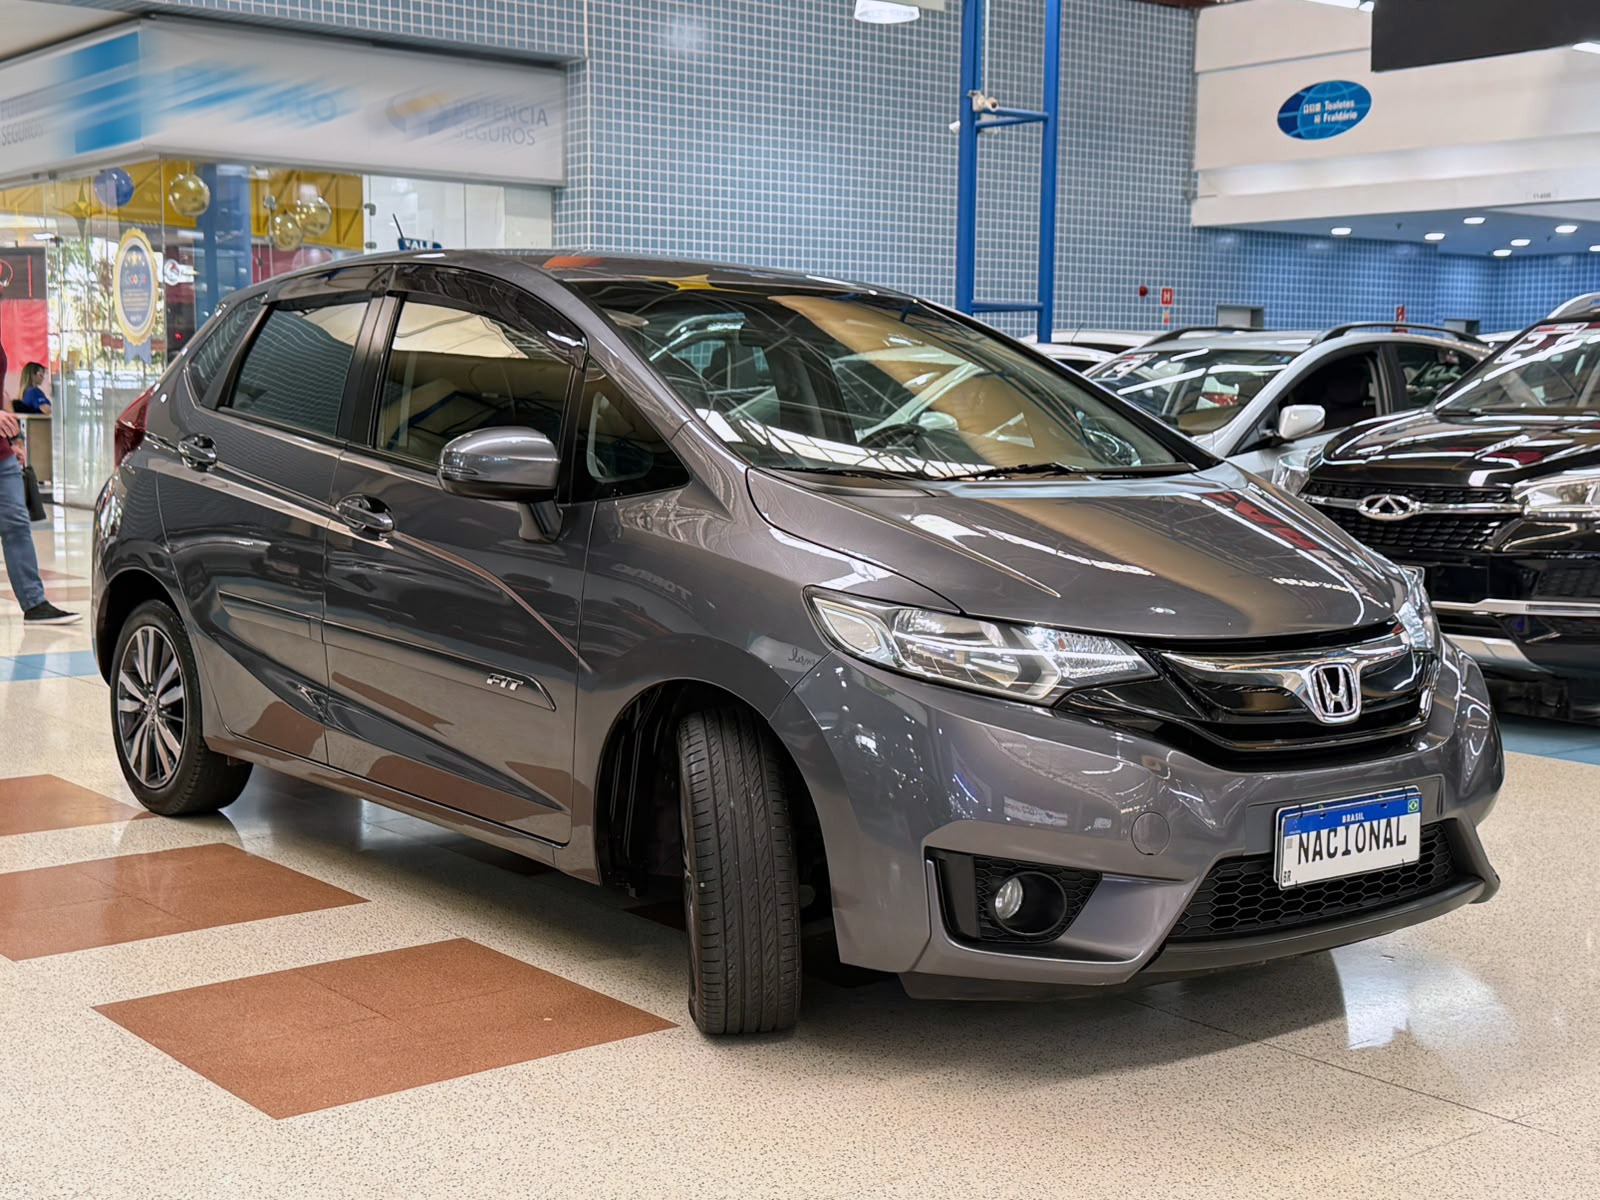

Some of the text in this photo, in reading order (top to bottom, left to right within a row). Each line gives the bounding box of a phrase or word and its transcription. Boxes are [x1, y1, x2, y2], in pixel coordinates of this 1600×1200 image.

[453, 122, 536, 146] SEGUROS
[486, 672, 524, 691] FIT
[1341, 811, 1365, 824] BRASIL
[1297, 817, 1408, 865] NACIONAL
